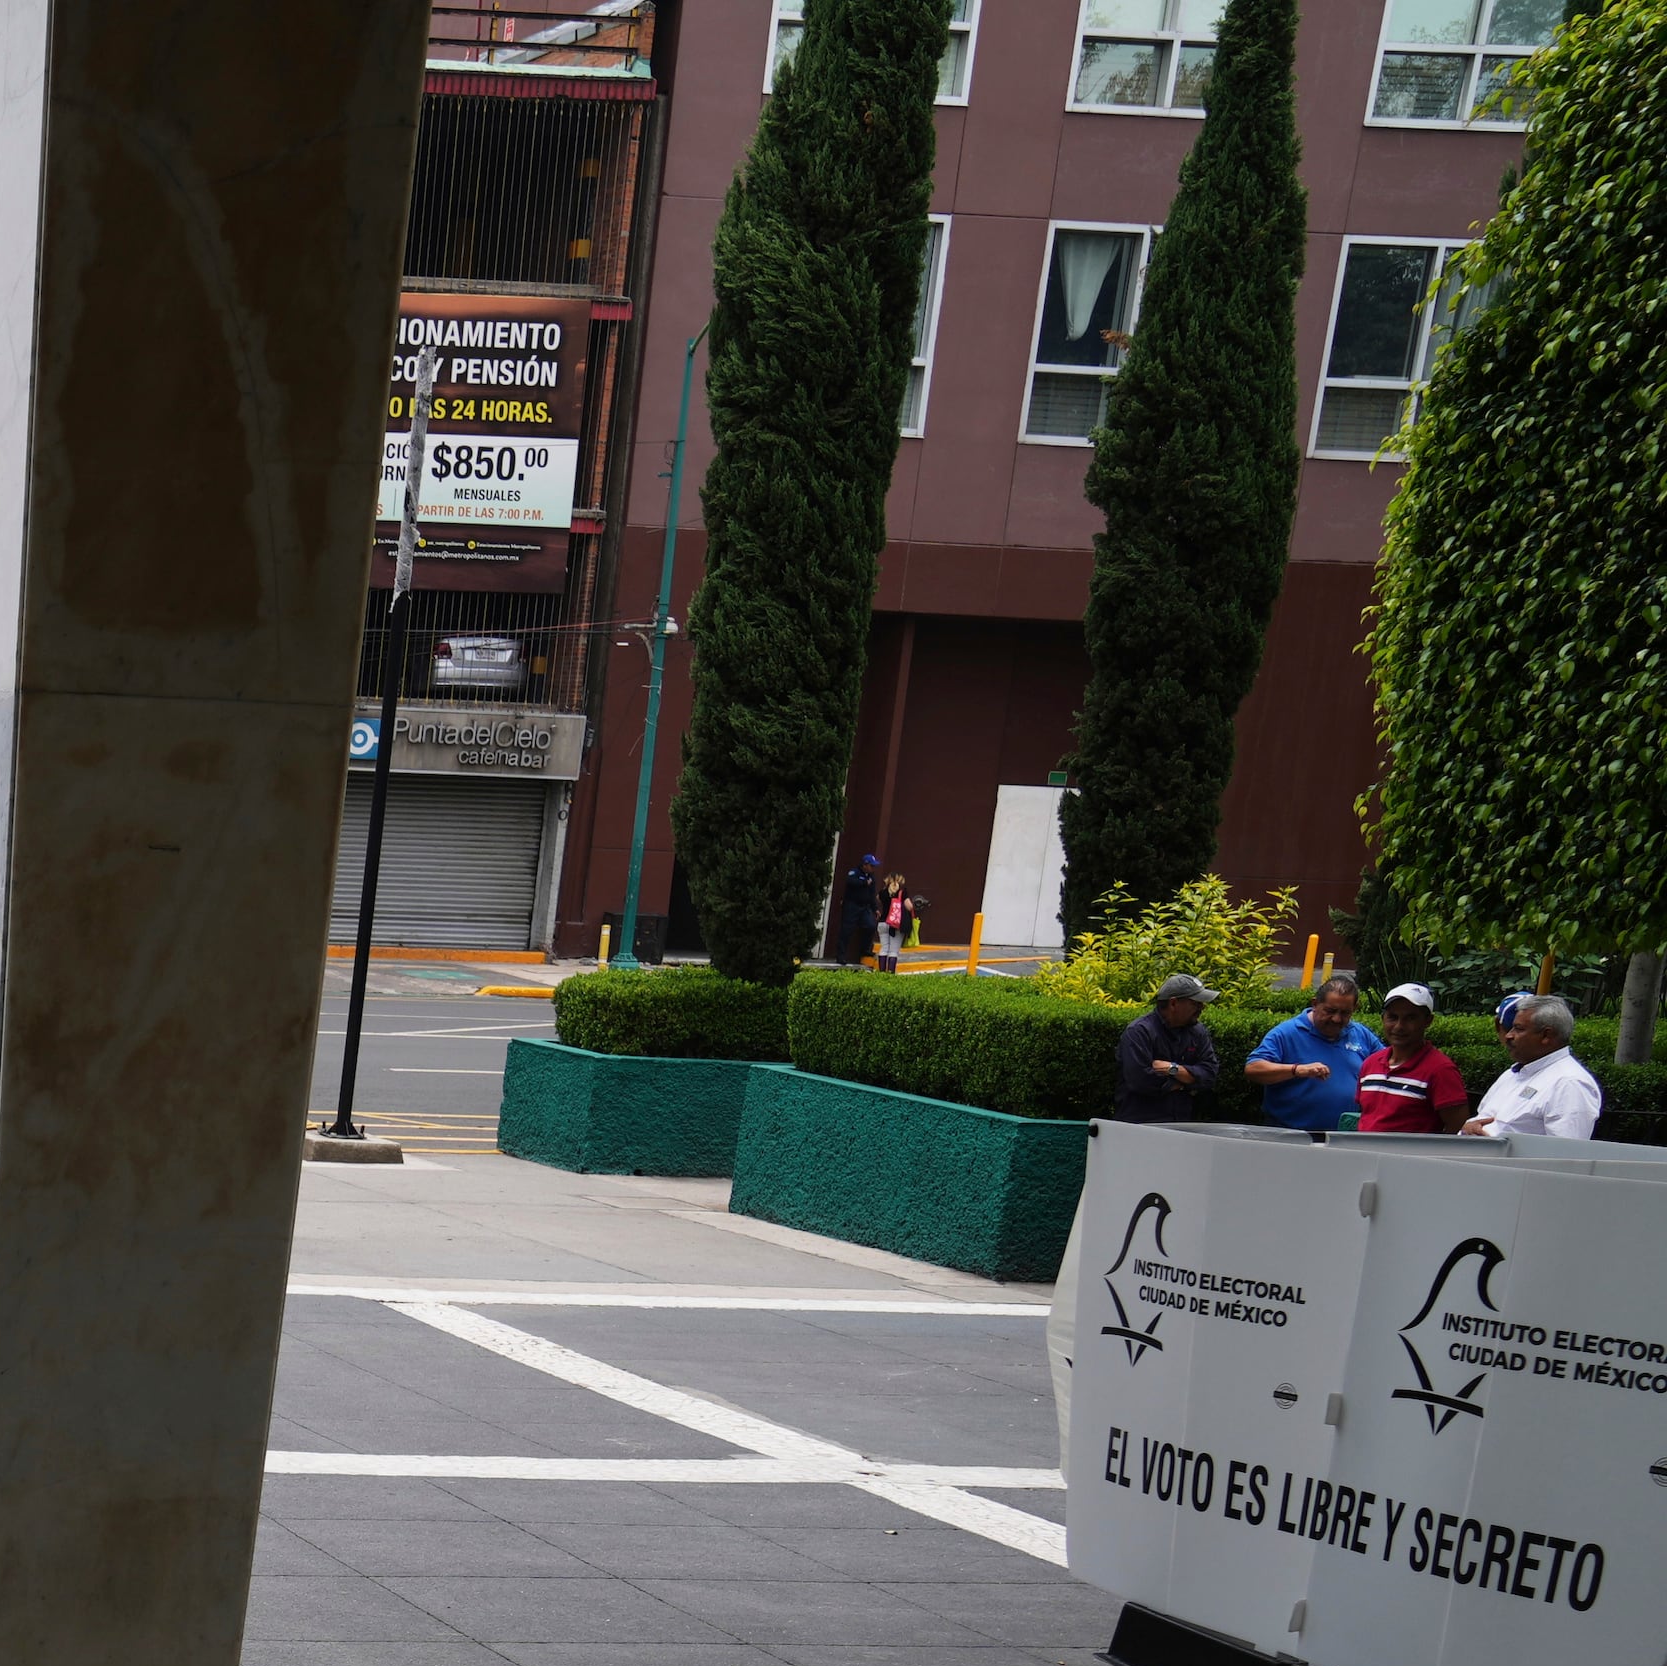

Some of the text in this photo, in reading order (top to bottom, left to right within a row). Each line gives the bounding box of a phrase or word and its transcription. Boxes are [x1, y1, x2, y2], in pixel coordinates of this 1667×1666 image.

[395, 318, 561, 350] IONAMIENTO
[451, 355, 558, 387] PENSIÓN
[451, 399, 475, 421] 24
[481, 400, 553, 424] HORAS.
[454, 488, 521, 501] MENSUALES
[458, 506, 471, 518] DE
[474, 507, 495, 519] LAS
[498, 508, 521, 520] 7:00
[523, 509, 545, 521] P.M.
[1133, 1258, 1307, 1305] INSTITUTO ELECTORAL
[1138, 1285, 1288, 1328] CIUDAD DE MÉXICO
[1441, 1312, 1667, 1364] INSTITUTO ELECTOR
[1448, 1342, 1667, 1394] CIUDAD DE MÉXICO
[1104, 1426, 1606, 1613] EL VOTO ES LIBRE Y SECRETO
